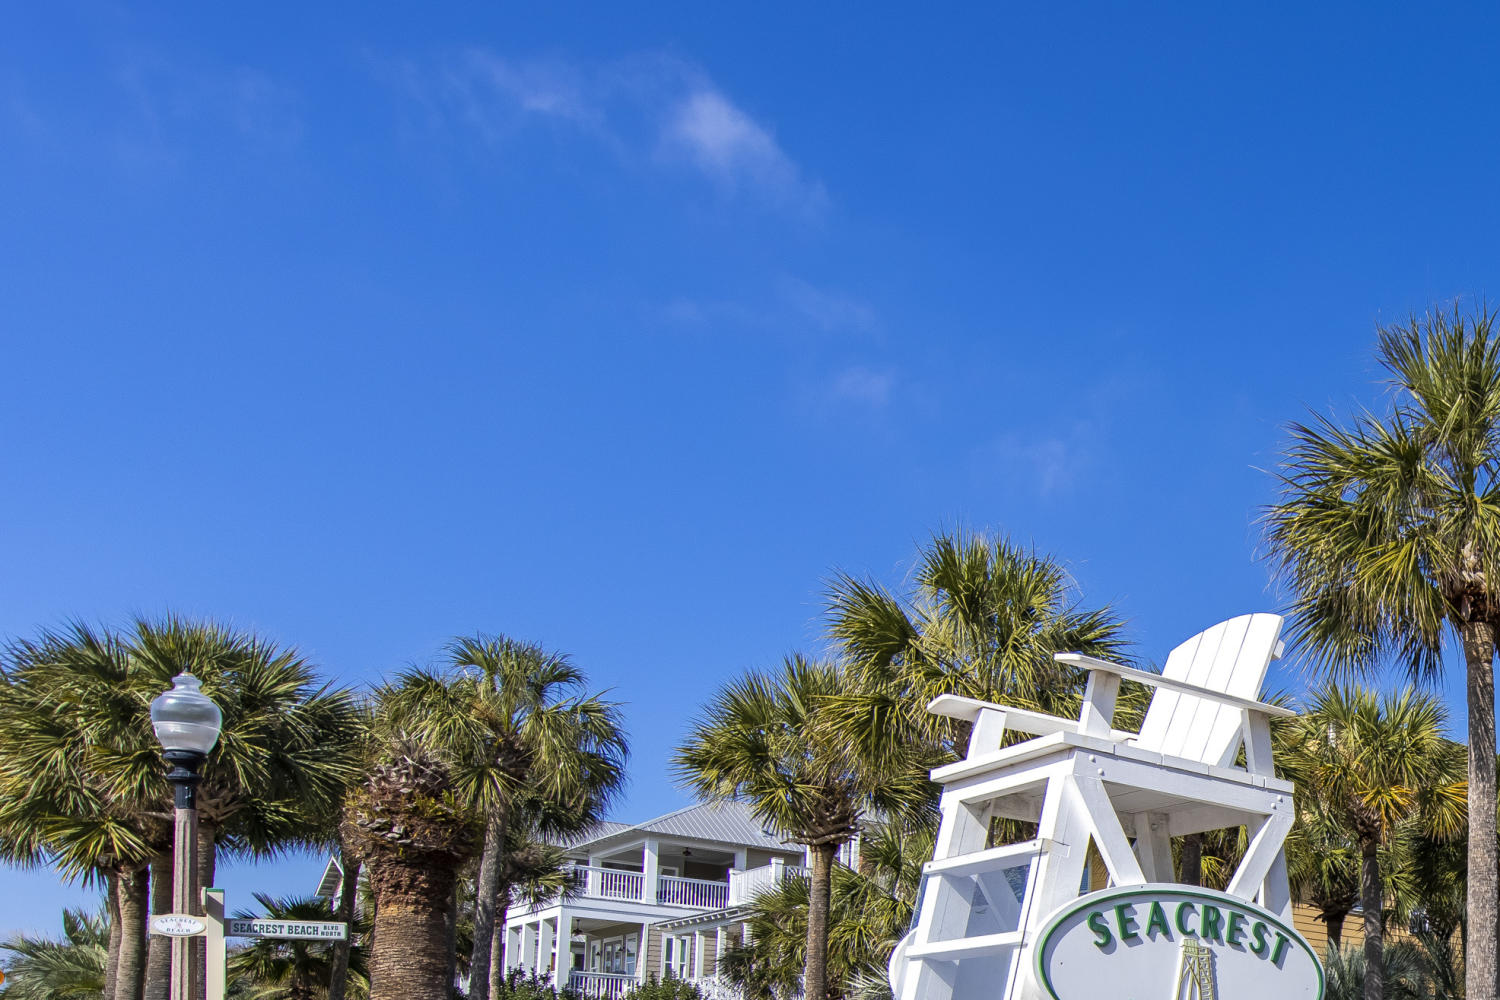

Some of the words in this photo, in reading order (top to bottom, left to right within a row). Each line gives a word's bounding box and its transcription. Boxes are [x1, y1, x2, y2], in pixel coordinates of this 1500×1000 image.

[233, 922, 284, 934] SEACREST
[287, 925, 319, 936] BEACH
[1087, 901, 1290, 965] SEACREST
